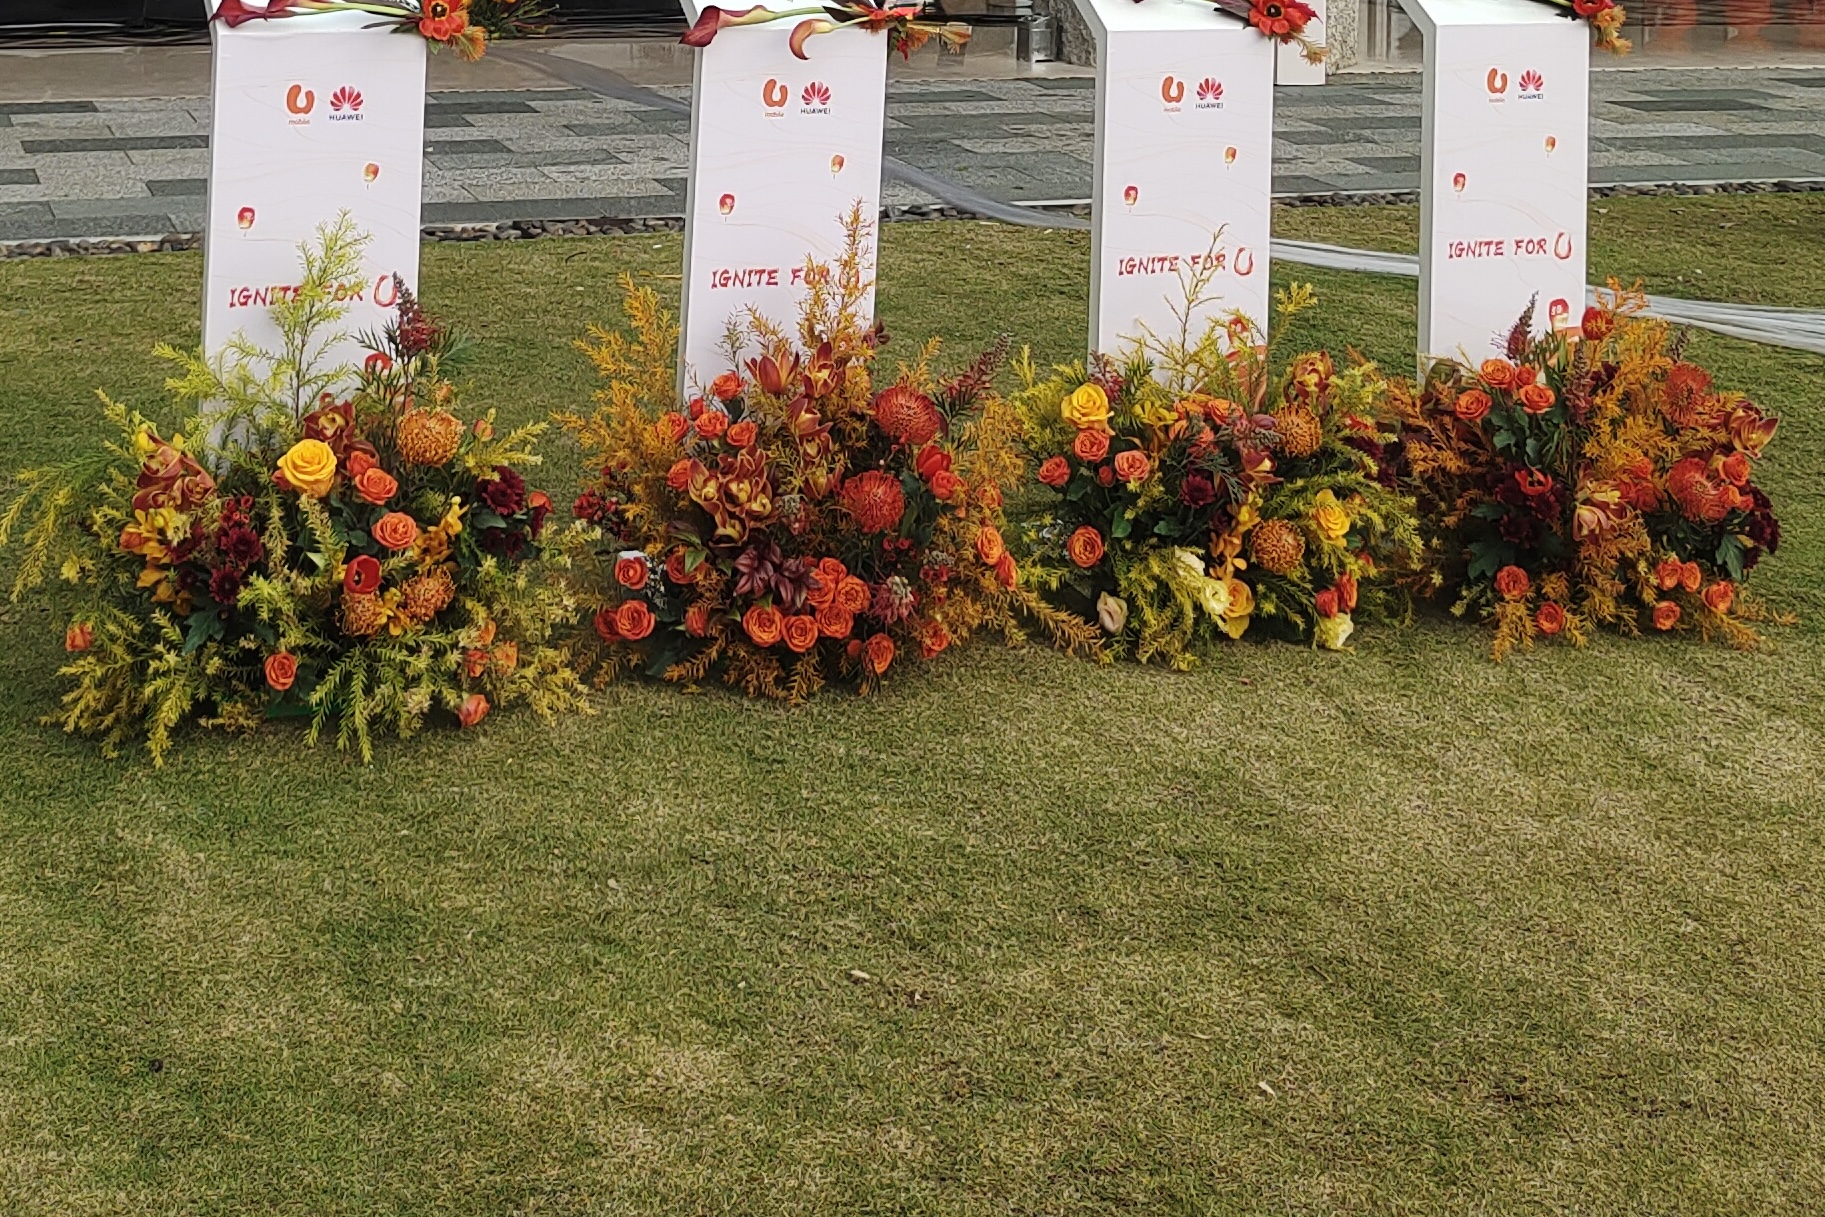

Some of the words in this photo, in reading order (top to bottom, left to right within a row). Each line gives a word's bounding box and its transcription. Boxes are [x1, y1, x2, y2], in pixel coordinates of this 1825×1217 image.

[1449, 240, 1504, 259] IGNITE
[1514, 238, 1547, 255] FOR
[1554, 232, 1572, 260] U
[1118, 256, 1180, 276] IGNITE
[1191, 253, 1226, 272] FOR
[1234, 247, 1254, 276] U
[711, 268, 779, 289] IGNITE
